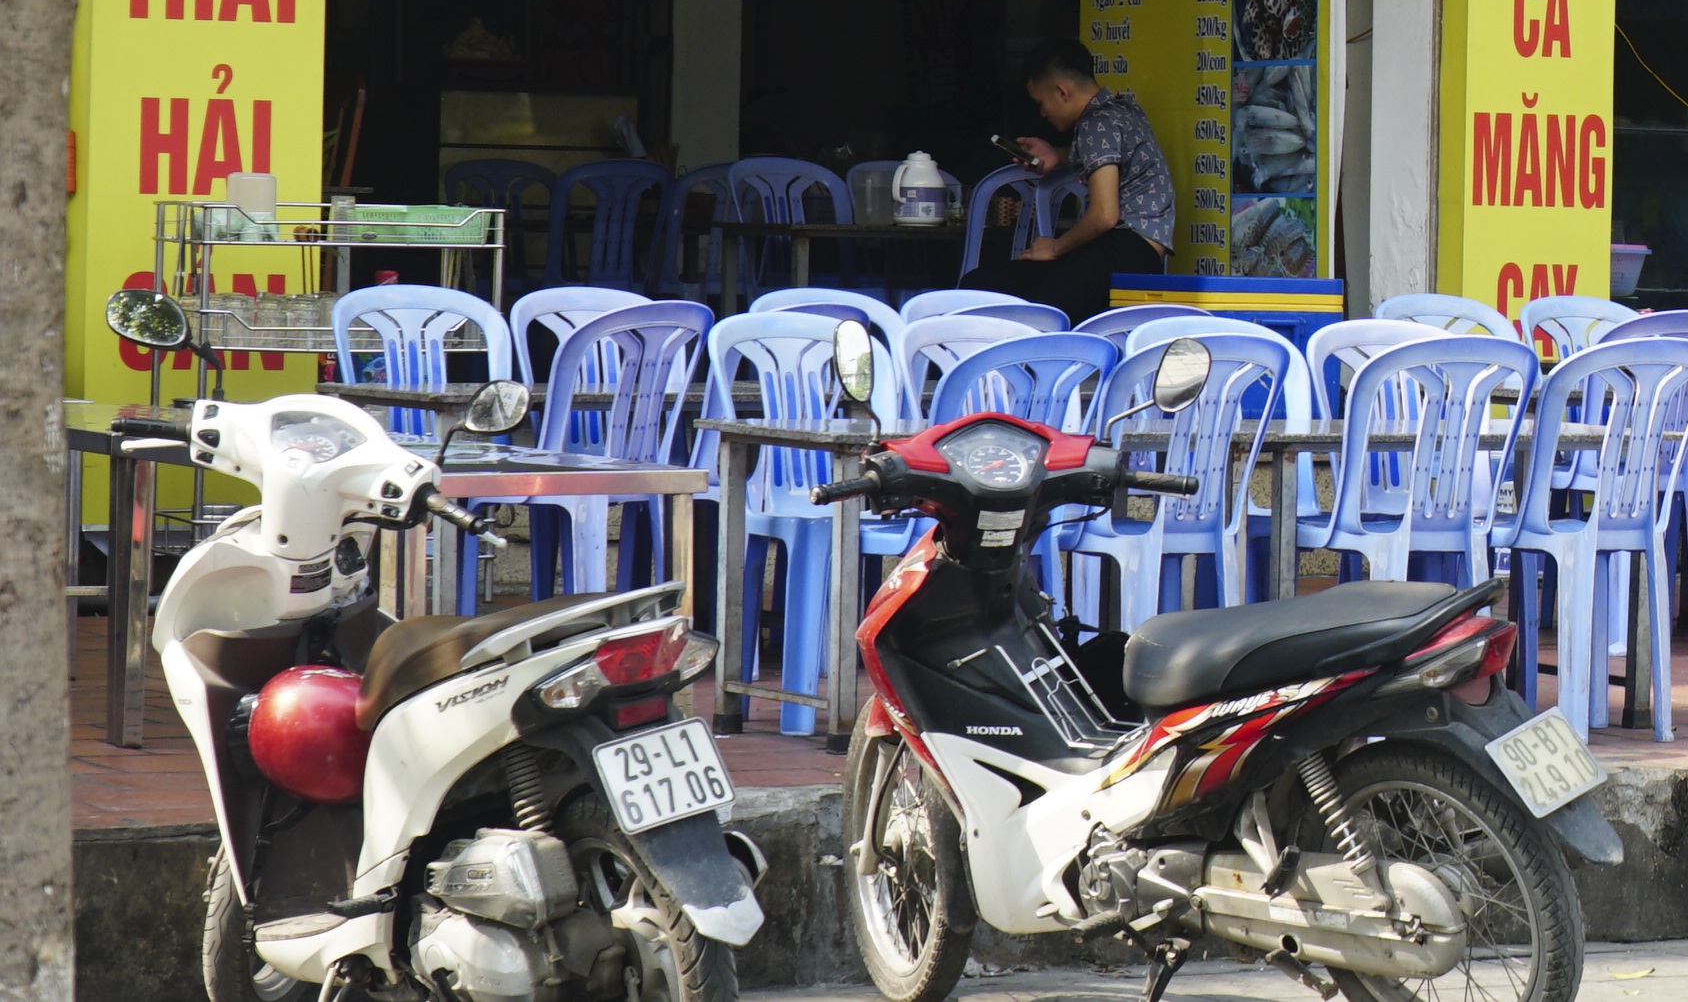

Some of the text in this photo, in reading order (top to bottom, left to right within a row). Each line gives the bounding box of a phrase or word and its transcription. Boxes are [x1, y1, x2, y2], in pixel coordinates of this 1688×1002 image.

[1091, 16, 1131, 46] Sò huyết
[1196, 17, 1227, 40] 320/kg
[1197, 51, 1226, 71] 20/con
[1195, 84, 1226, 110] 450/kg
[139, 63, 272, 196] HẢI
[1195, 118, 1226, 143] 650/kg
[1472, 92, 1606, 210] MĂNG
[1195, 153, 1226, 178] 650/kg
[1194, 188, 1226, 213] 580/kg
[1190, 222, 1225, 248] 1150/kg
[435, 675, 510, 713] VISION
[966, 725, 1023, 736] HONDA
[614, 729, 699, 782] 29-L1
[1502, 719, 1569, 772] 90-B1
[1521, 747, 1597, 807] 249.10
[620, 765, 726, 825] 617.06
